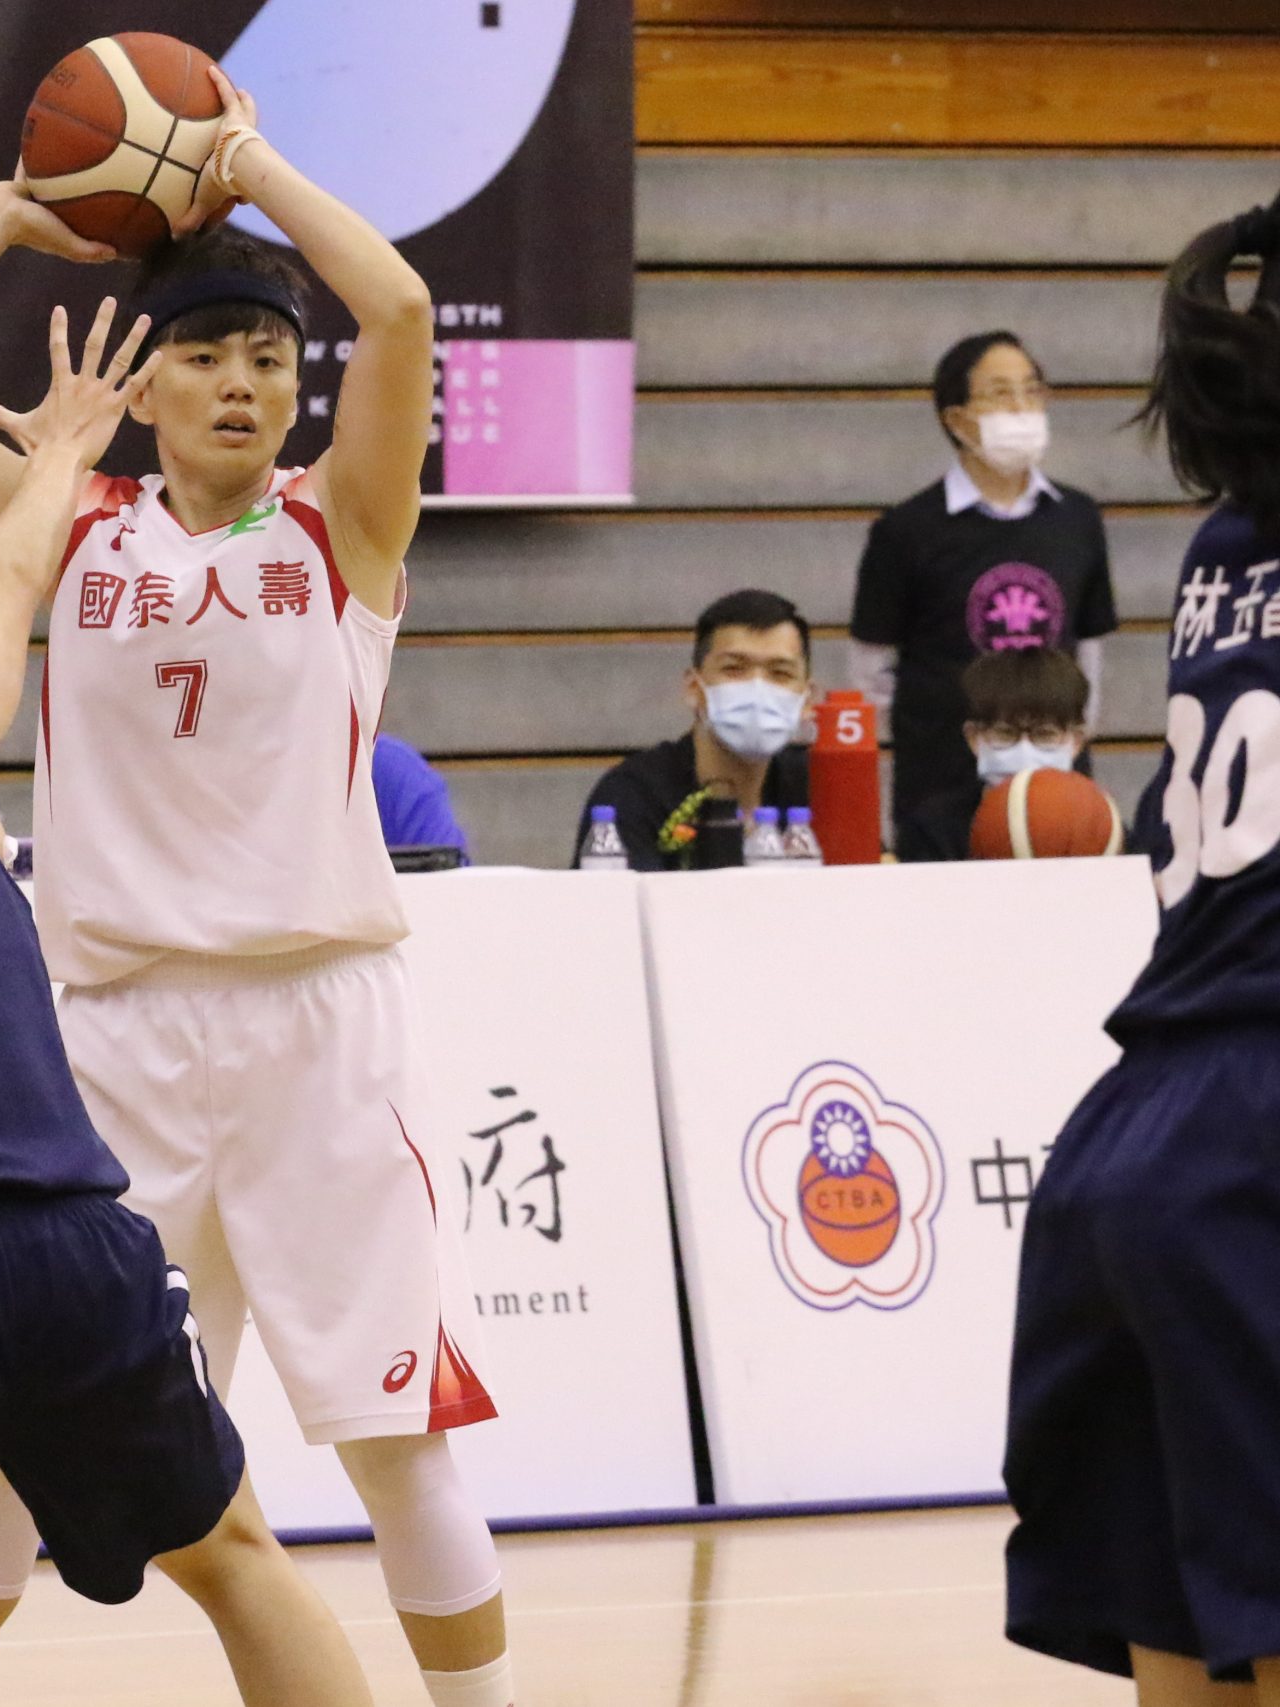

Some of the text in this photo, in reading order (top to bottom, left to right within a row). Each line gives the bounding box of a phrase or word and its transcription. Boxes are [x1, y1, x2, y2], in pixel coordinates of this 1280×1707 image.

[79, 561, 312, 629] 國泰人壽
[155, 659, 208, 738] 7
[836, 708, 864, 744] 5
[460, 1086, 566, 1243] 府
[816, 1188, 884, 1211] CTBA
[971, 1138, 1058, 1229] 中
